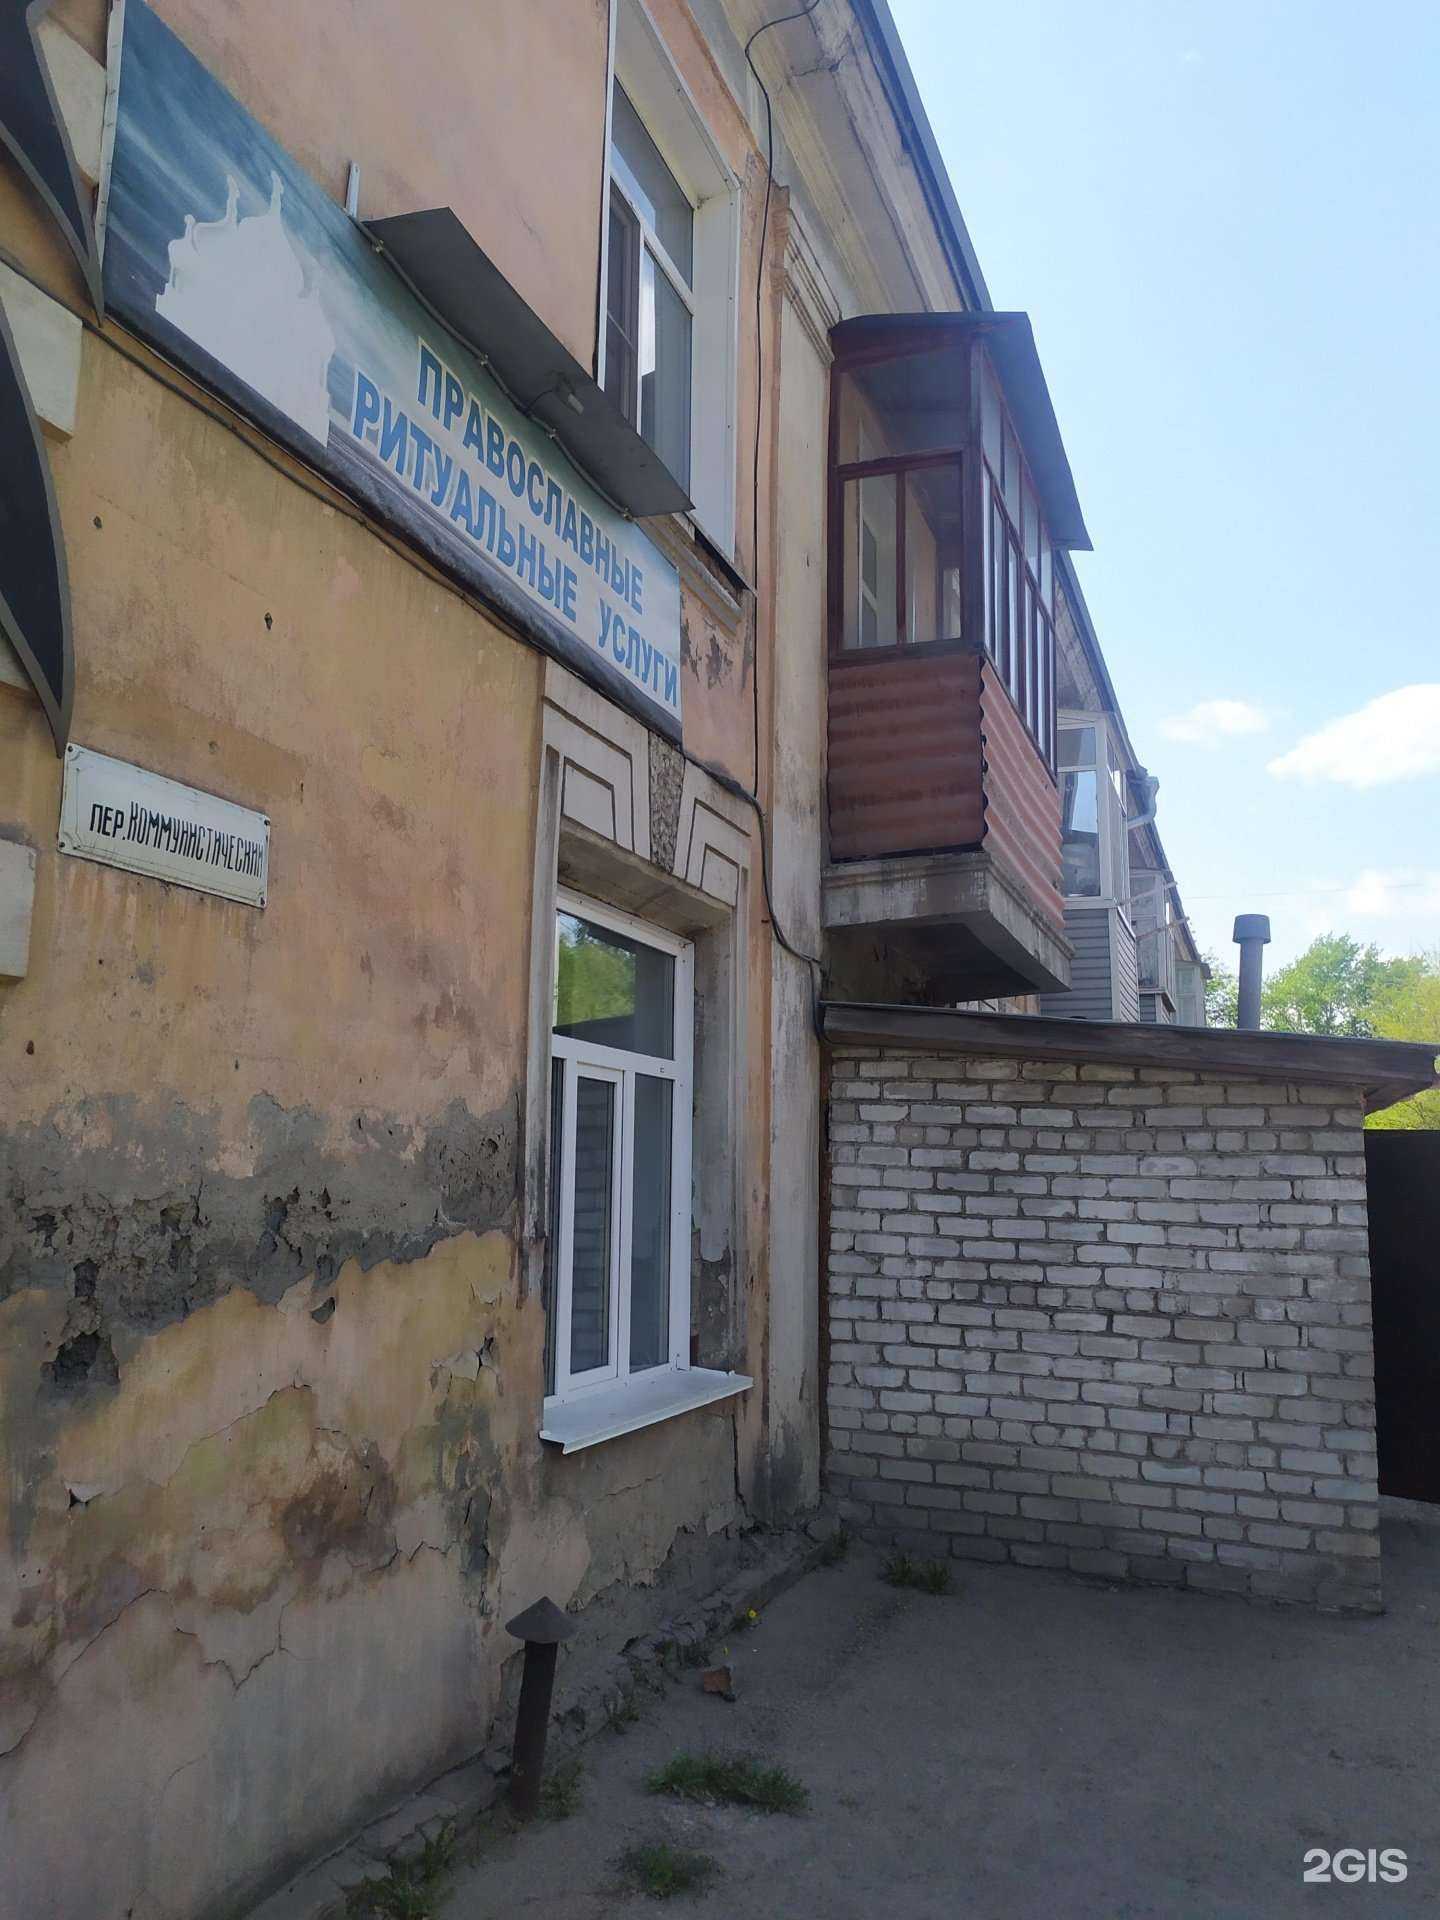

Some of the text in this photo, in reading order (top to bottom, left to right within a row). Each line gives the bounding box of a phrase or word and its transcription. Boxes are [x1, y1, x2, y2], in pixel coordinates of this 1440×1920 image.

[352, 371, 678, 706] РИТУАЛЬНЫЕ УСЛУГИ
[417, 343, 644, 616] ПРАВОСЛАВНЫЕ
